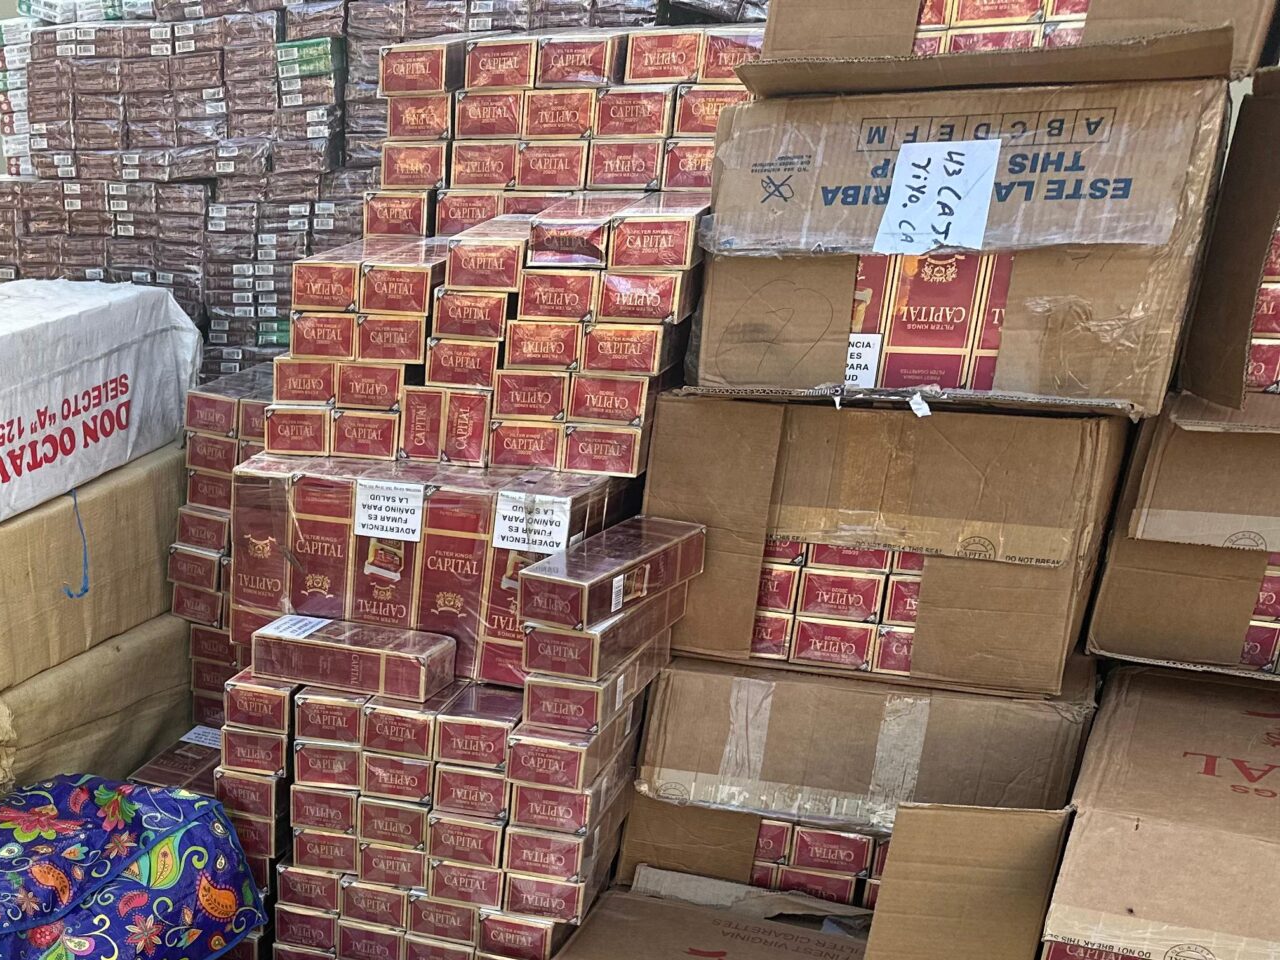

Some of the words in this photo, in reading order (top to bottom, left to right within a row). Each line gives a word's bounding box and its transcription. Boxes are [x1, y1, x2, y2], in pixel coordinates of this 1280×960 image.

[393, 61, 431, 76] CAPITAL
[551, 54, 593, 68] CAPITAL
[467, 106, 508, 120] CAPITAL
[938, 124, 955, 142] E
[1011, 121, 1027, 143] C
[1047, 118, 1063, 137] B
[1084, 116, 1103, 134] A
[867, 126, 885, 144] M
[1008, 151, 1086, 173] THIS
[821, 185, 891, 206] RIBA
[994, 180, 1033, 202] LA
[1044, 178, 1132, 200] ESTE
[377, 206, 413, 221] CAPITAL
[461, 256, 505, 272] CAPITAL
[535, 292, 579, 308] CAPITAL
[448, 306, 491, 323] CAPITAL
[900, 307, 966, 323] CAPITAL
[61, 374, 129, 421] SELECTO
[82, 400, 131, 448] DON
[278, 423, 314, 438] CAPITAL
[414, 404, 427, 446] CAPITAL
[503, 437, 545, 452] CAPITAL
[370, 494, 394, 502] SALUD
[361, 503, 385, 511] PARA
[381, 516, 408, 524] FUMAR
[501, 514, 524, 522] PARA
[508, 525, 519, 533] ES
[521, 527, 552, 536] FUMAR
[295, 540, 344, 558] CAPITAL
[956, 550, 992, 560] CAPITAL
[427, 556, 479, 576] CAPITAL
[237, 572, 281, 592] CAPITAL
[816, 591, 863, 606] CAPITAL
[358, 599, 406, 619] CAPITAL
[538, 644, 581, 660] CAPITAL
[809, 638, 856, 654] CAPITAL
[237, 701, 274, 715] CAPITAL
[375, 723, 417, 740] CAPITAL
[521, 755, 567, 773] CAPITAL
[371, 821, 412, 835] CAPITAL
[306, 842, 346, 857] CAPITAL
[421, 909, 462, 926] CAPITAL
[712, 918, 810, 946] CIGARETTES
[721, 930, 788, 950] VIRGINIA
